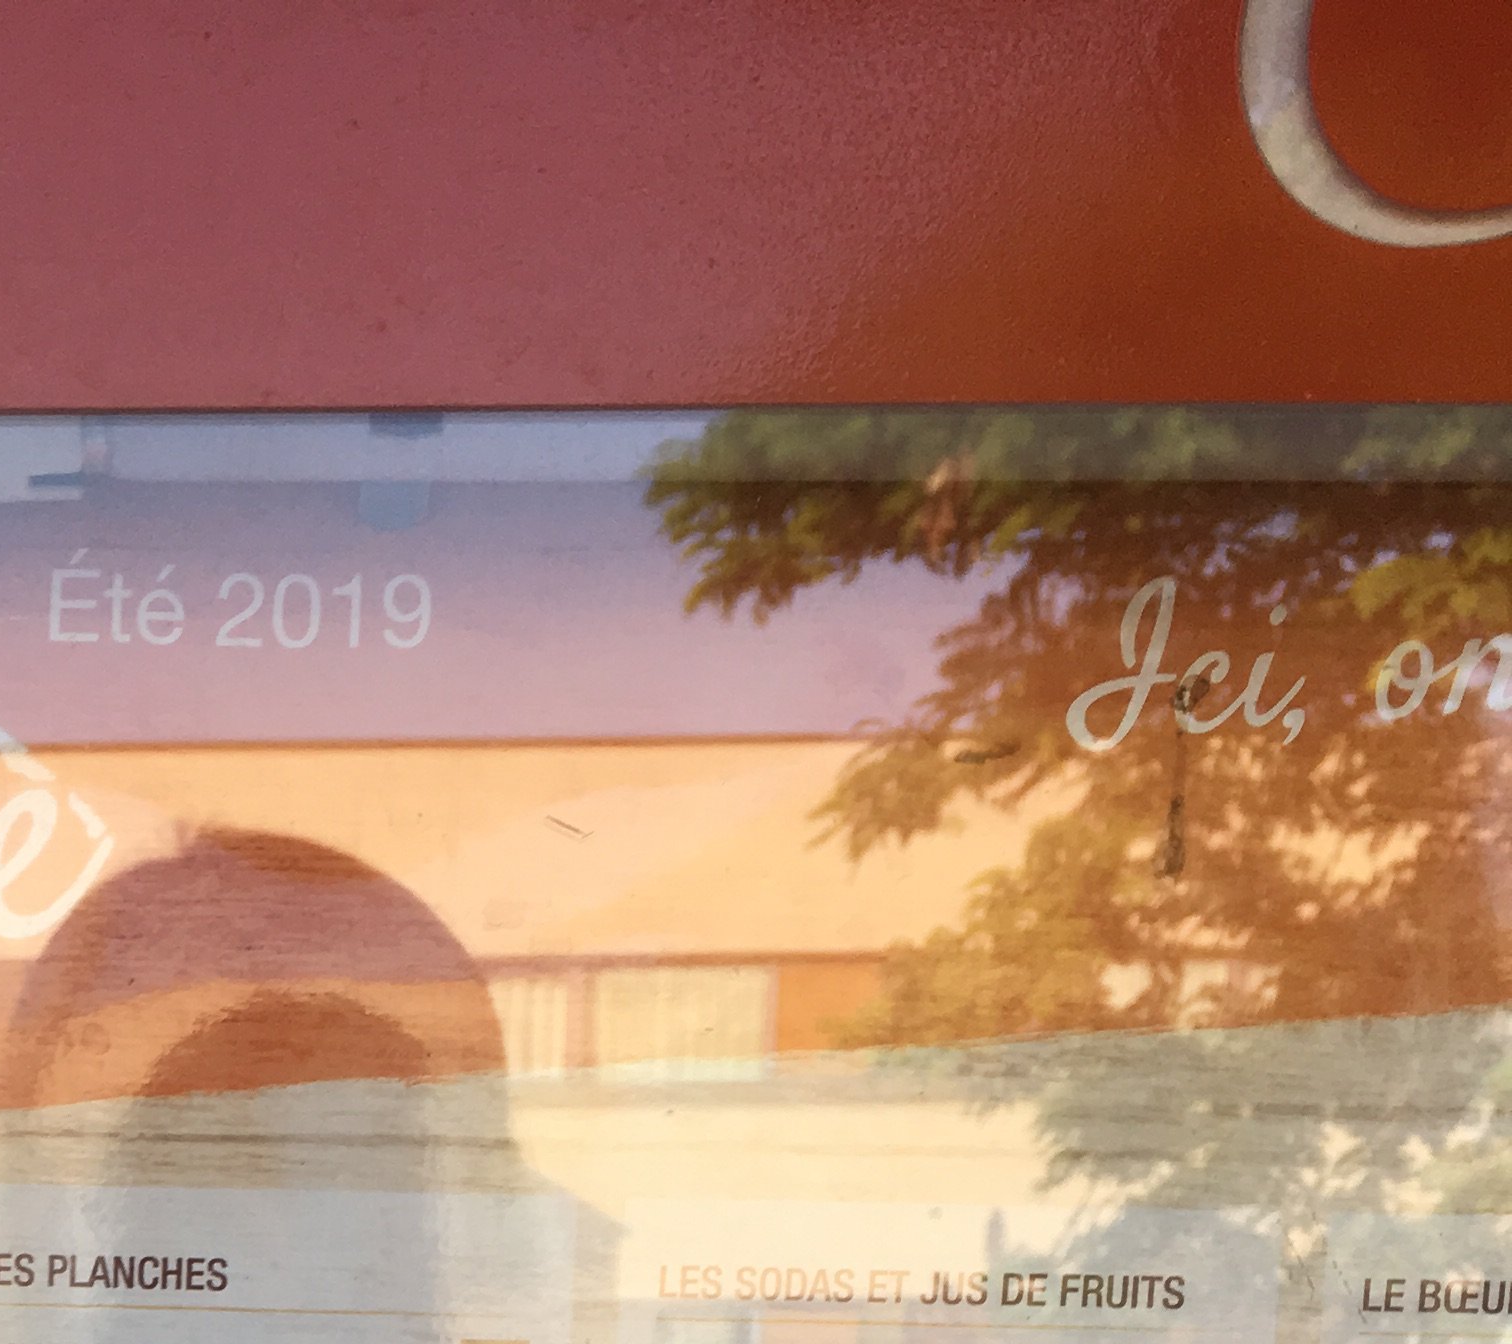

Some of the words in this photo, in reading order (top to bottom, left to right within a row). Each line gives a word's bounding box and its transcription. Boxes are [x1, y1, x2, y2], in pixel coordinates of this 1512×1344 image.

[50, 547, 185, 645] Été
[216, 572, 431, 648] 2019
[48, 1254, 229, 1292] PLANCHES
[658, 1266, 723, 1300] LES
[735, 1267, 853, 1303] SODAS
[867, 1271, 909, 1304] ET
[920, 1272, 988, 1305] JUS
[1001, 1273, 1047, 1307] DE
[1060, 1274, 1185, 1310] FRUITS
[1362, 1278, 1406, 1312] LE
[1418, 1279, 1512, 1314] BŒU
